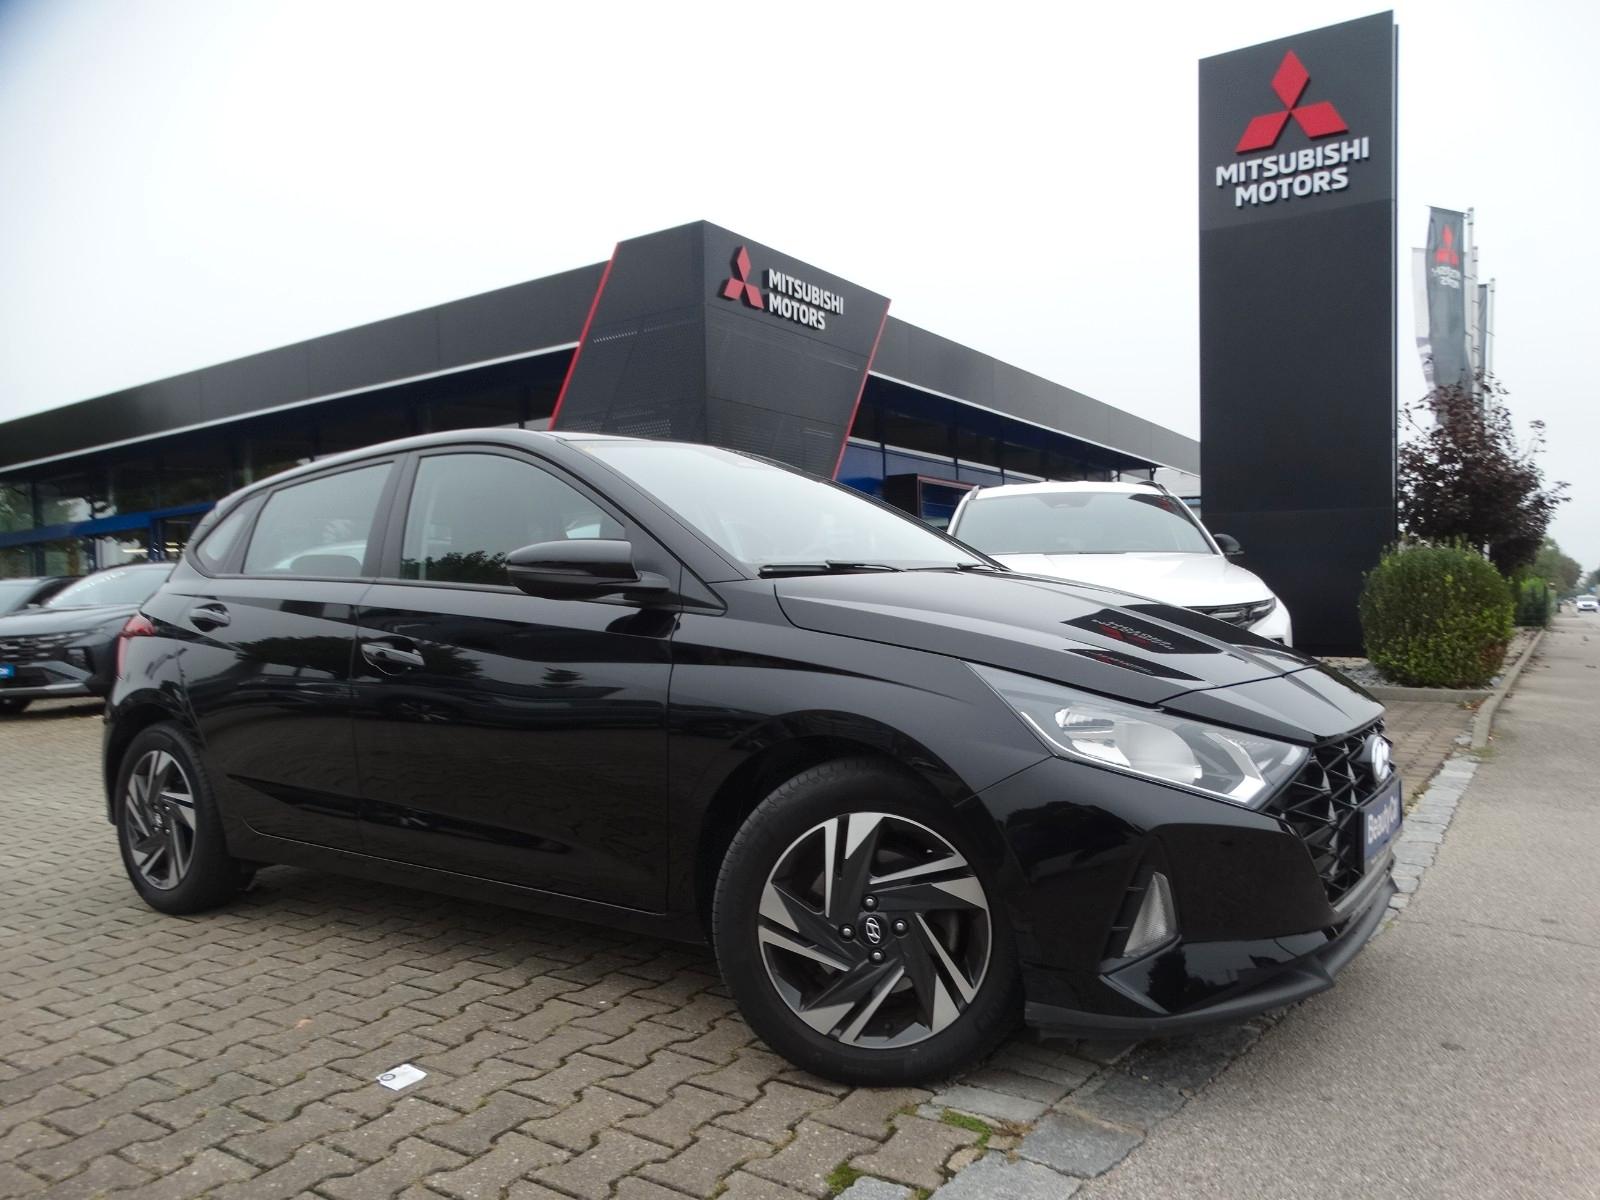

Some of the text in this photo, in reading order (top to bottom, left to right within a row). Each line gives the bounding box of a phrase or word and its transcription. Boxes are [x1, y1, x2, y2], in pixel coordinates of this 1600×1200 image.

[1216, 137, 1369, 186] MITSUBISHI
[1235, 168, 1348, 207] MOTORS
[769, 268, 844, 315] MITSUBISHI
[769, 293, 826, 330] MOTORS
